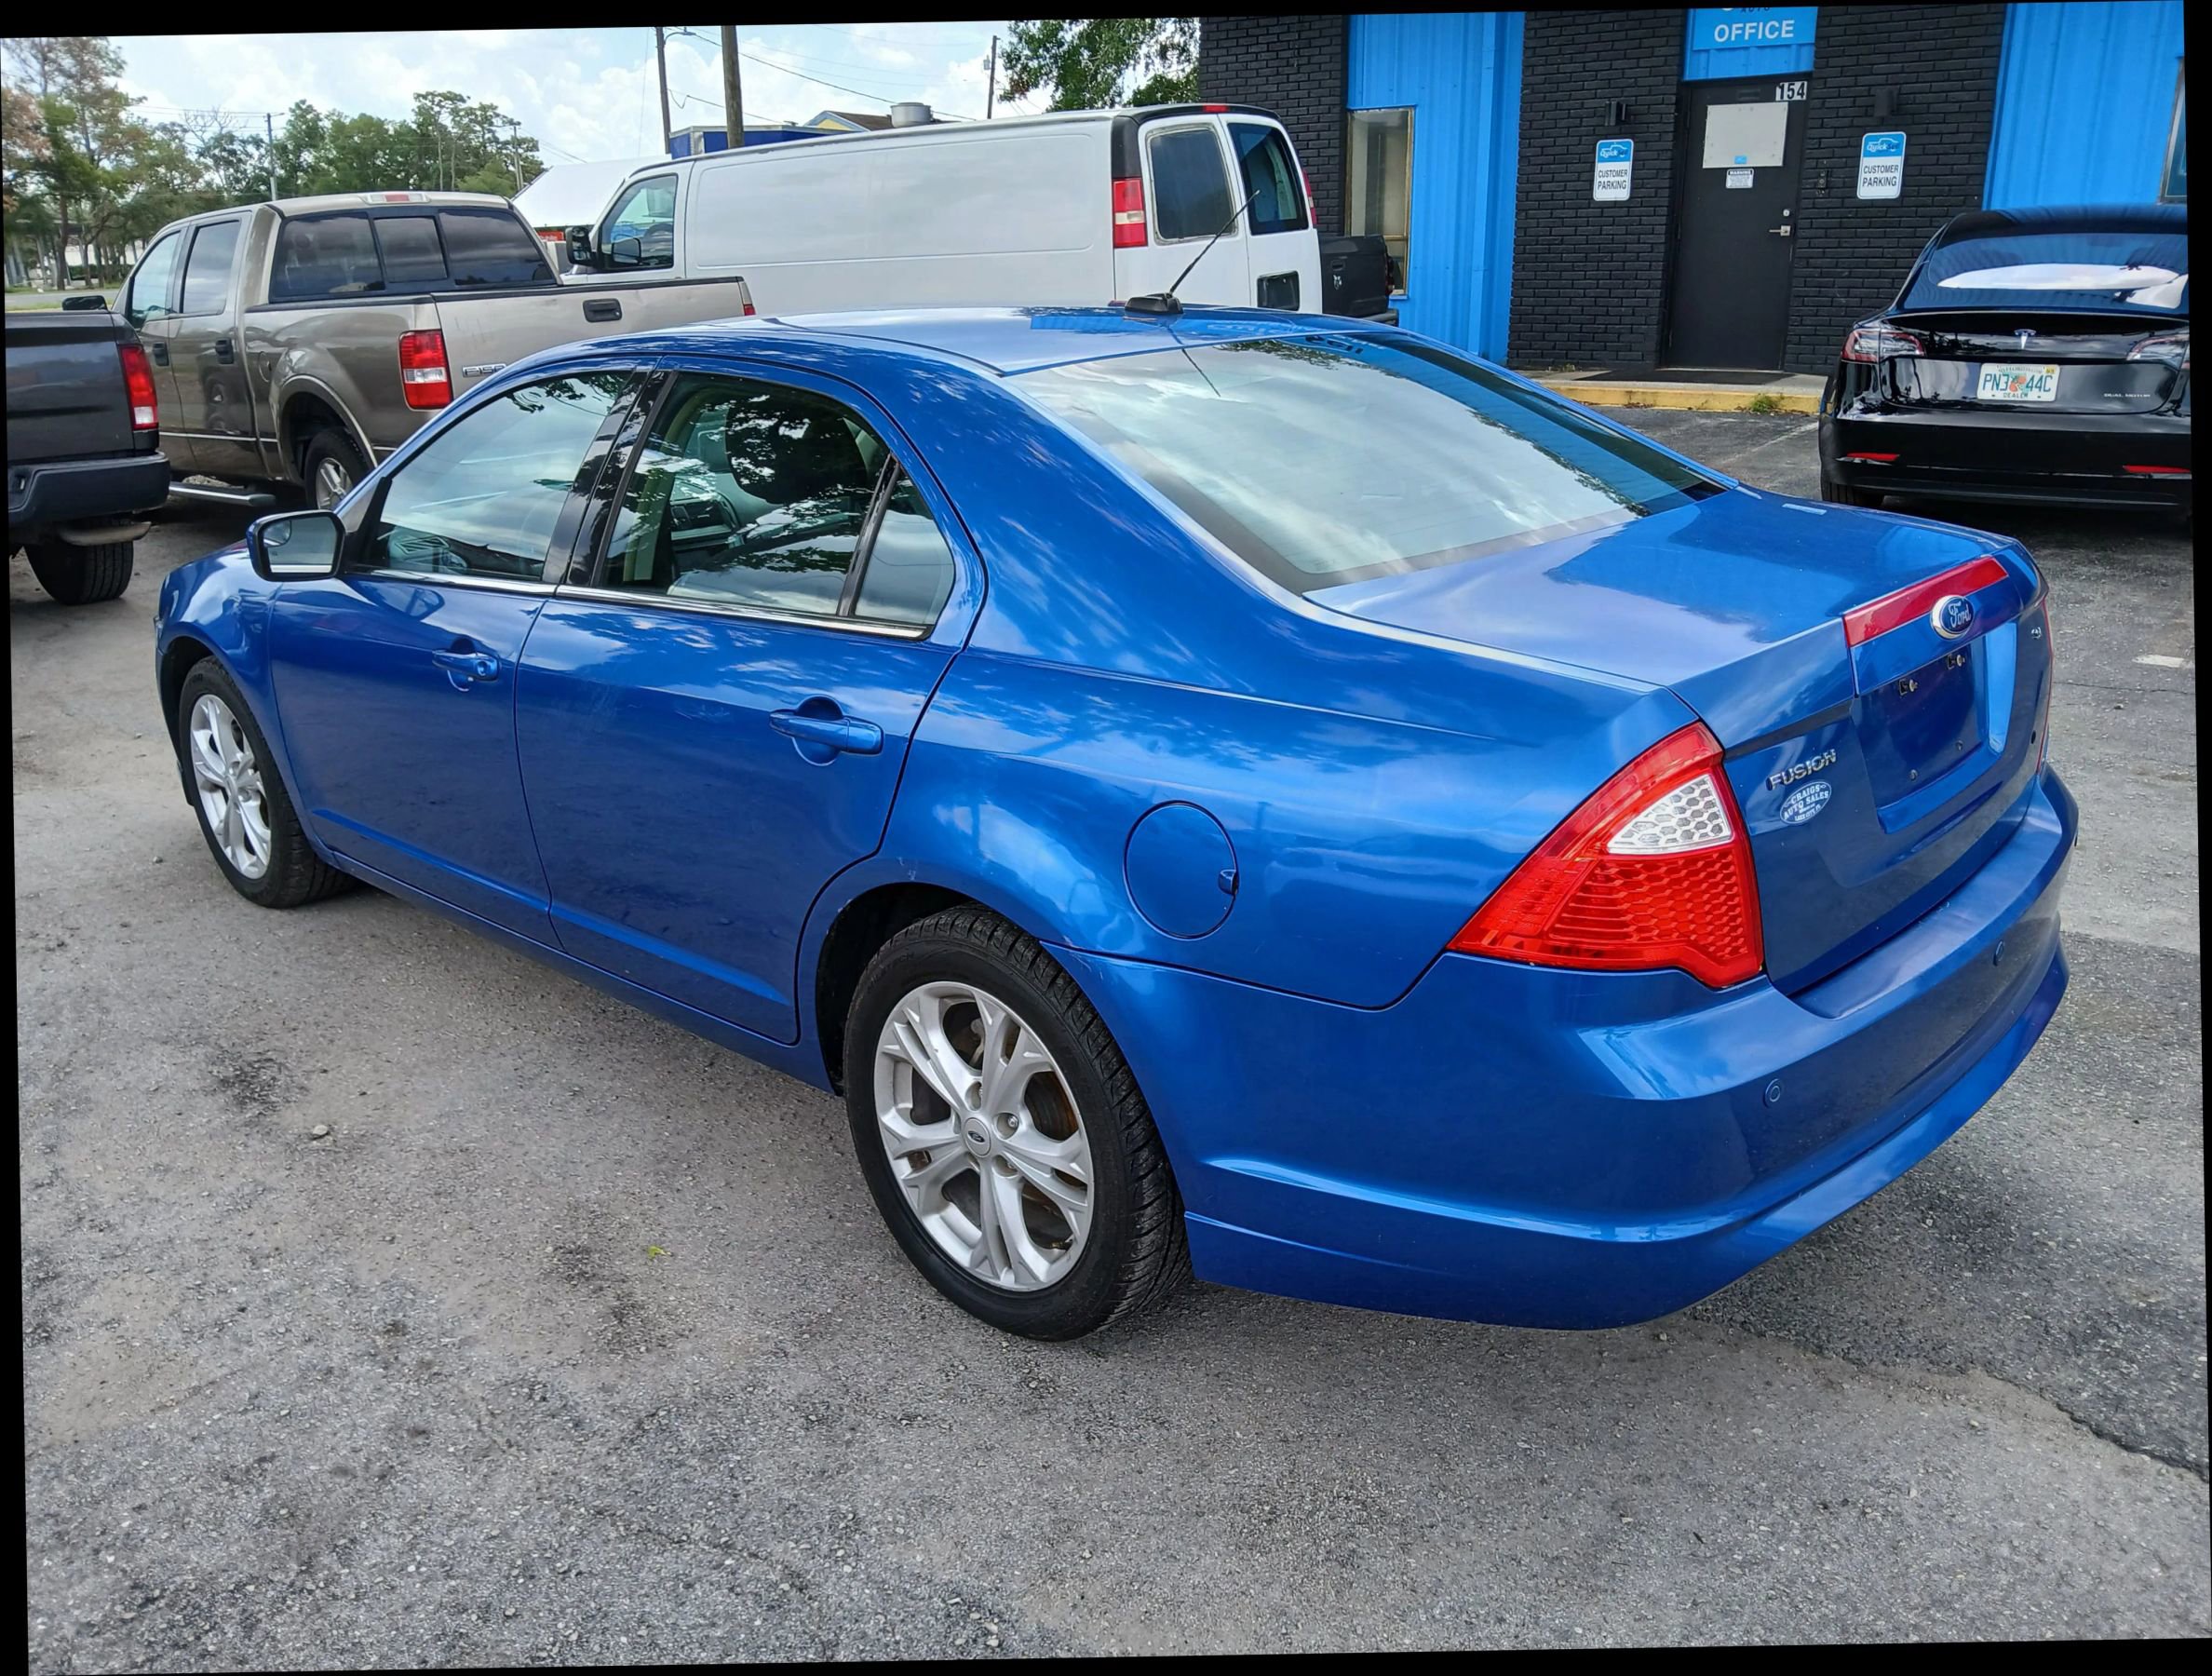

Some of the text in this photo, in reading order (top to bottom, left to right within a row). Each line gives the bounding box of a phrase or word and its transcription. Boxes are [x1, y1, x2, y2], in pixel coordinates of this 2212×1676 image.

[1714, 20, 1795, 42] OFFICE
[1779, 82, 1805, 100] 154
[1598, 169, 1628, 178] CUSTOMER
[1863, 165, 1899, 174] CUSTOMER
[1598, 180, 1626, 190] PARKING
[1863, 176, 1897, 187] PARKING
[1949, 601, 1972, 628] Ford
[1768, 749, 1837, 791] FUSION
[1791, 784, 1820, 804] CRAIGS
[1784, 801, 1803, 820] AUTO
[1806, 791, 1828, 804] SALES
